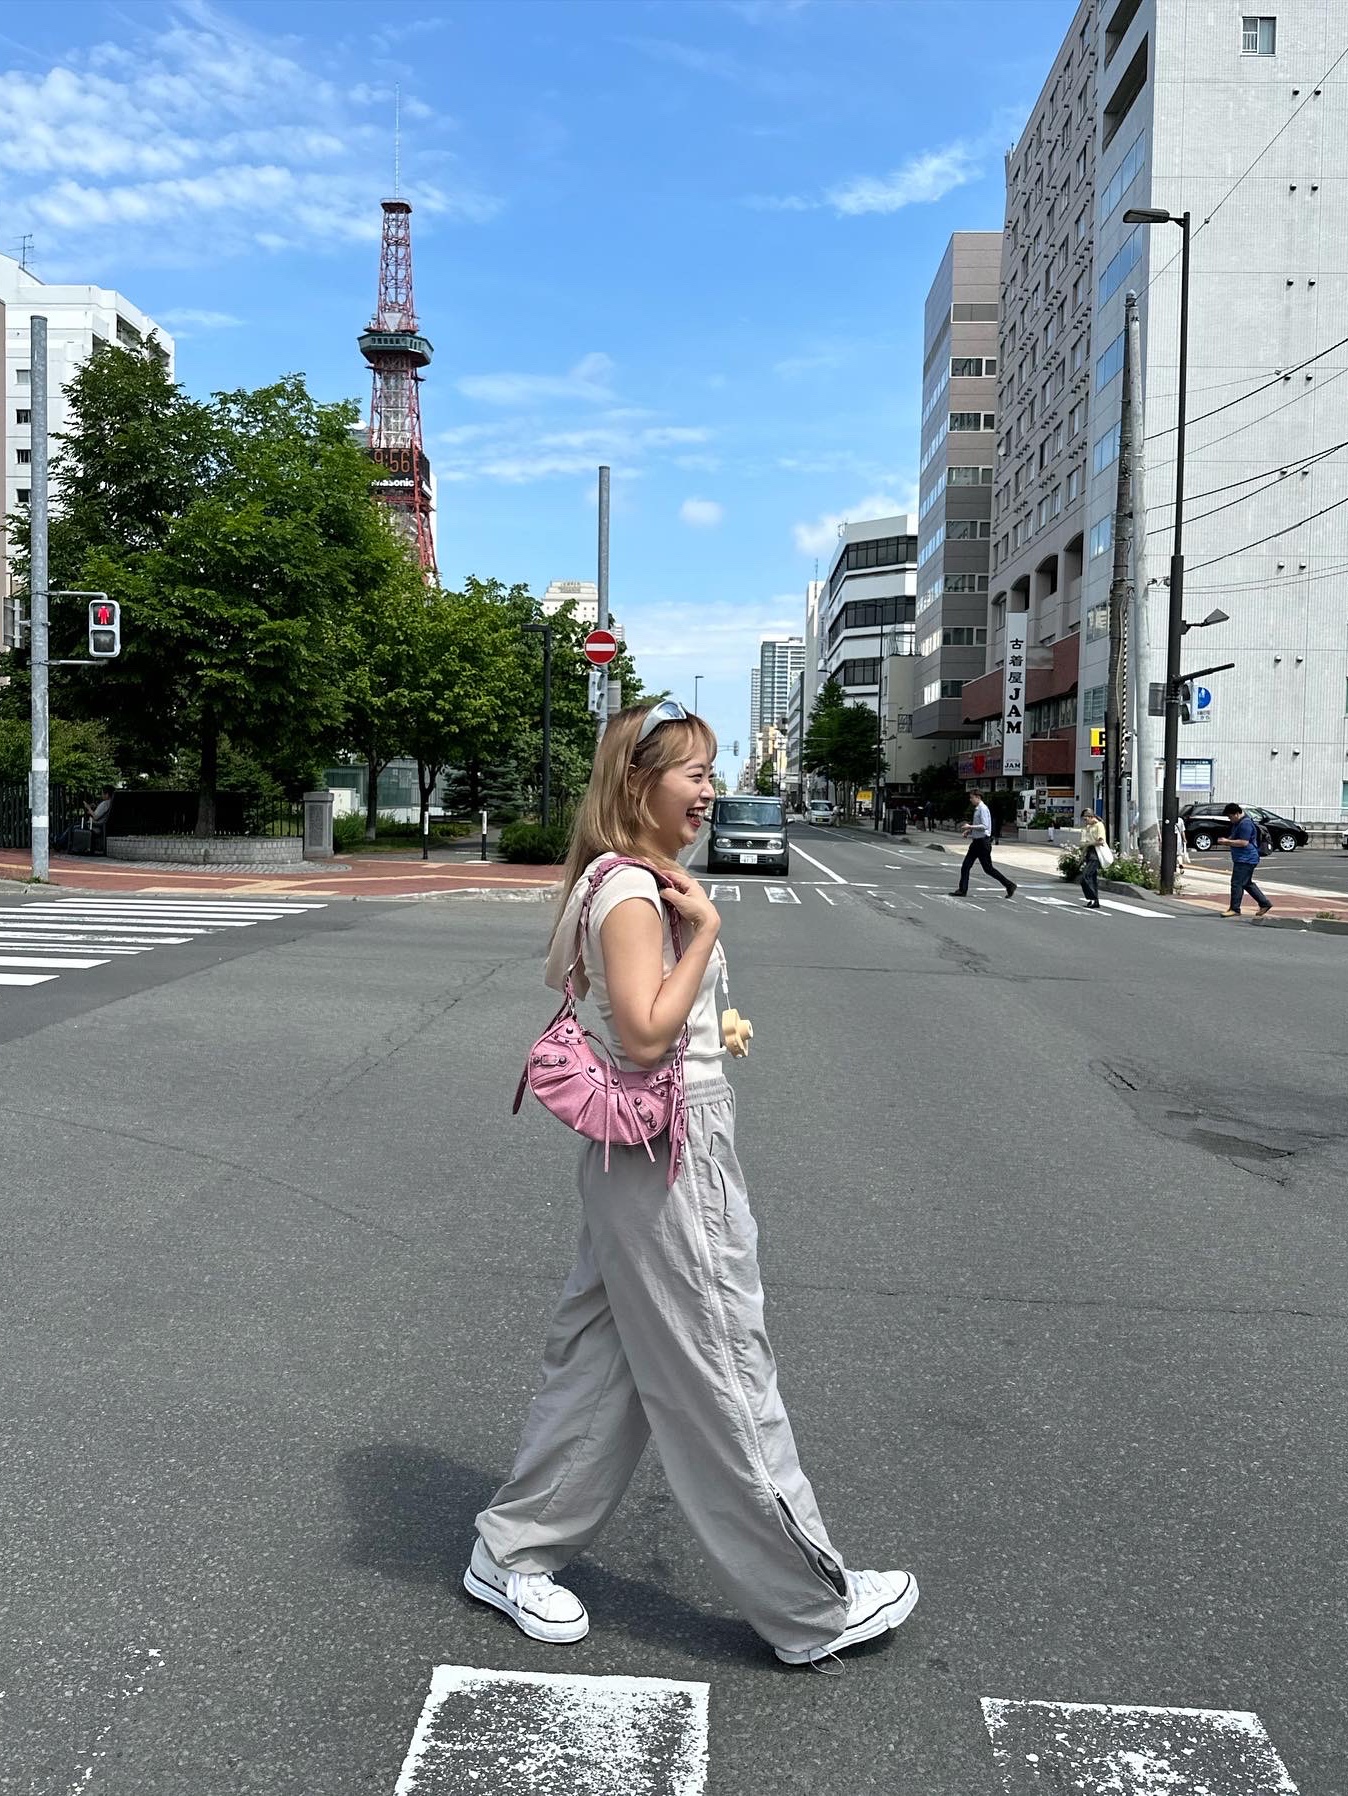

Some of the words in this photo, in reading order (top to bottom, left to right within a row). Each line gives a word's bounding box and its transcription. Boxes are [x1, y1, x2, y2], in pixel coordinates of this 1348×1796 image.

[374, 448, 410, 473] 9:56
[1006, 638, 1024, 734] 古着屋JAM
